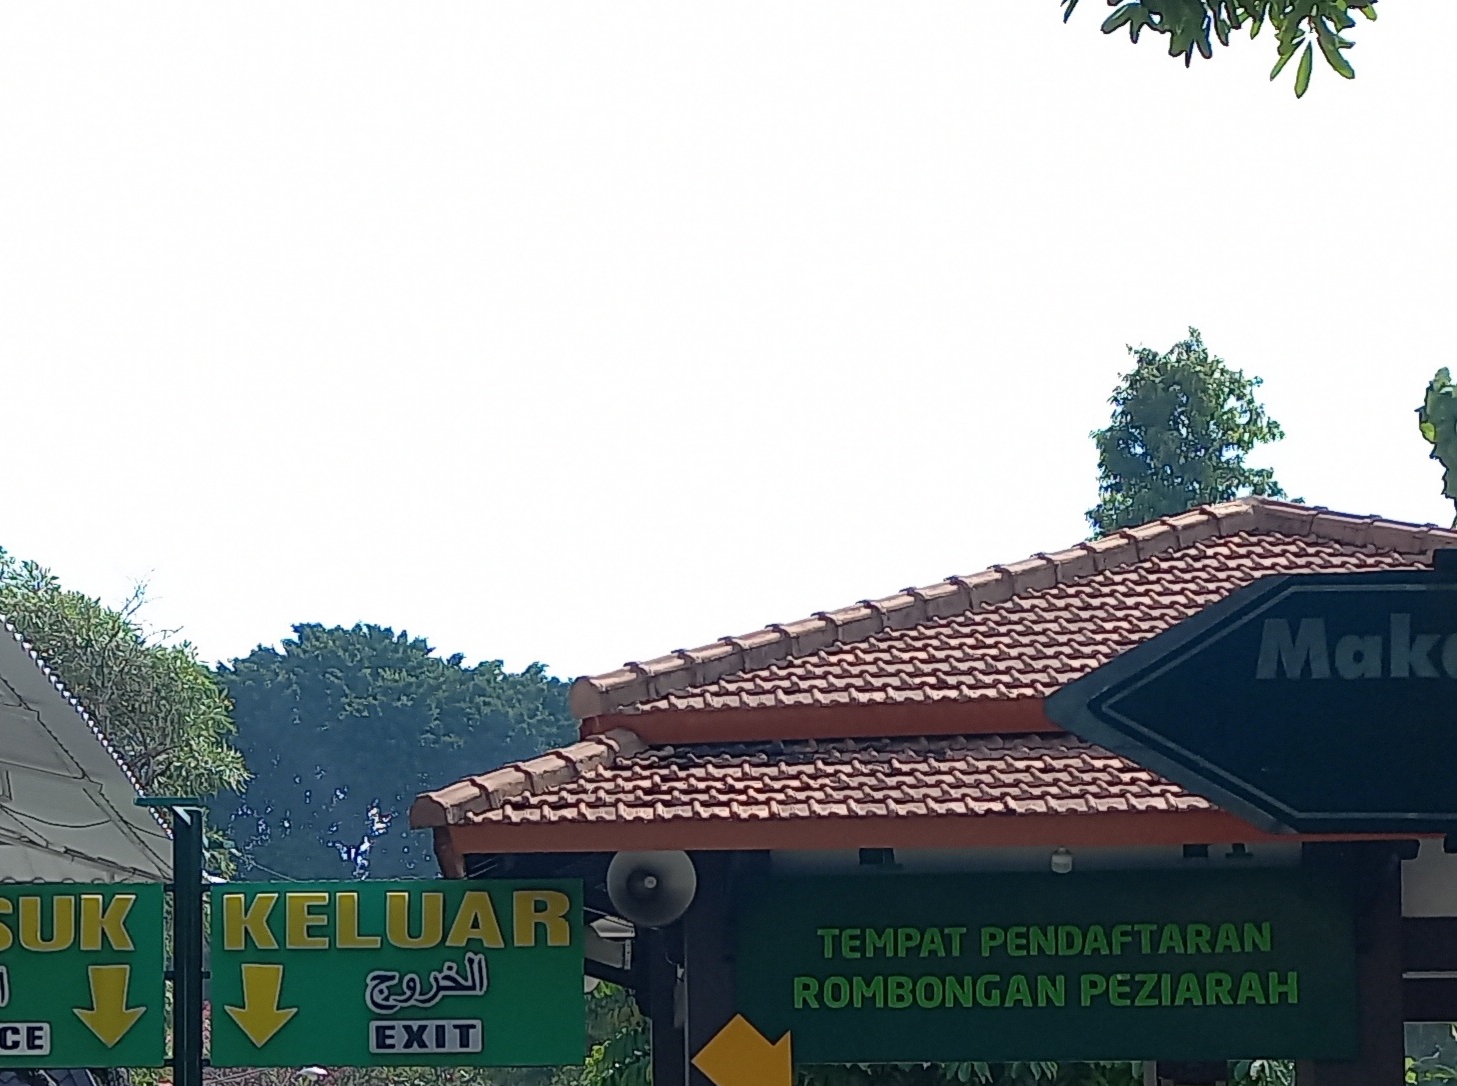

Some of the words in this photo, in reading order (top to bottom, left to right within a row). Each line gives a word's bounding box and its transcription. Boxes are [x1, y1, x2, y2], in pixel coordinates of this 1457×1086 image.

[222, 890, 571, 951] KELUAR
[817, 926, 967, 958] TEMPAT
[981, 922, 1272, 956] PENDAFTARAN
[366, 951, 488, 1014] الخروج
[793, 974, 1066, 1009] ROMBONGAN
[1080, 971, 1299, 1006] PEZIARAH
[374, 1023, 477, 1050] EXIT
